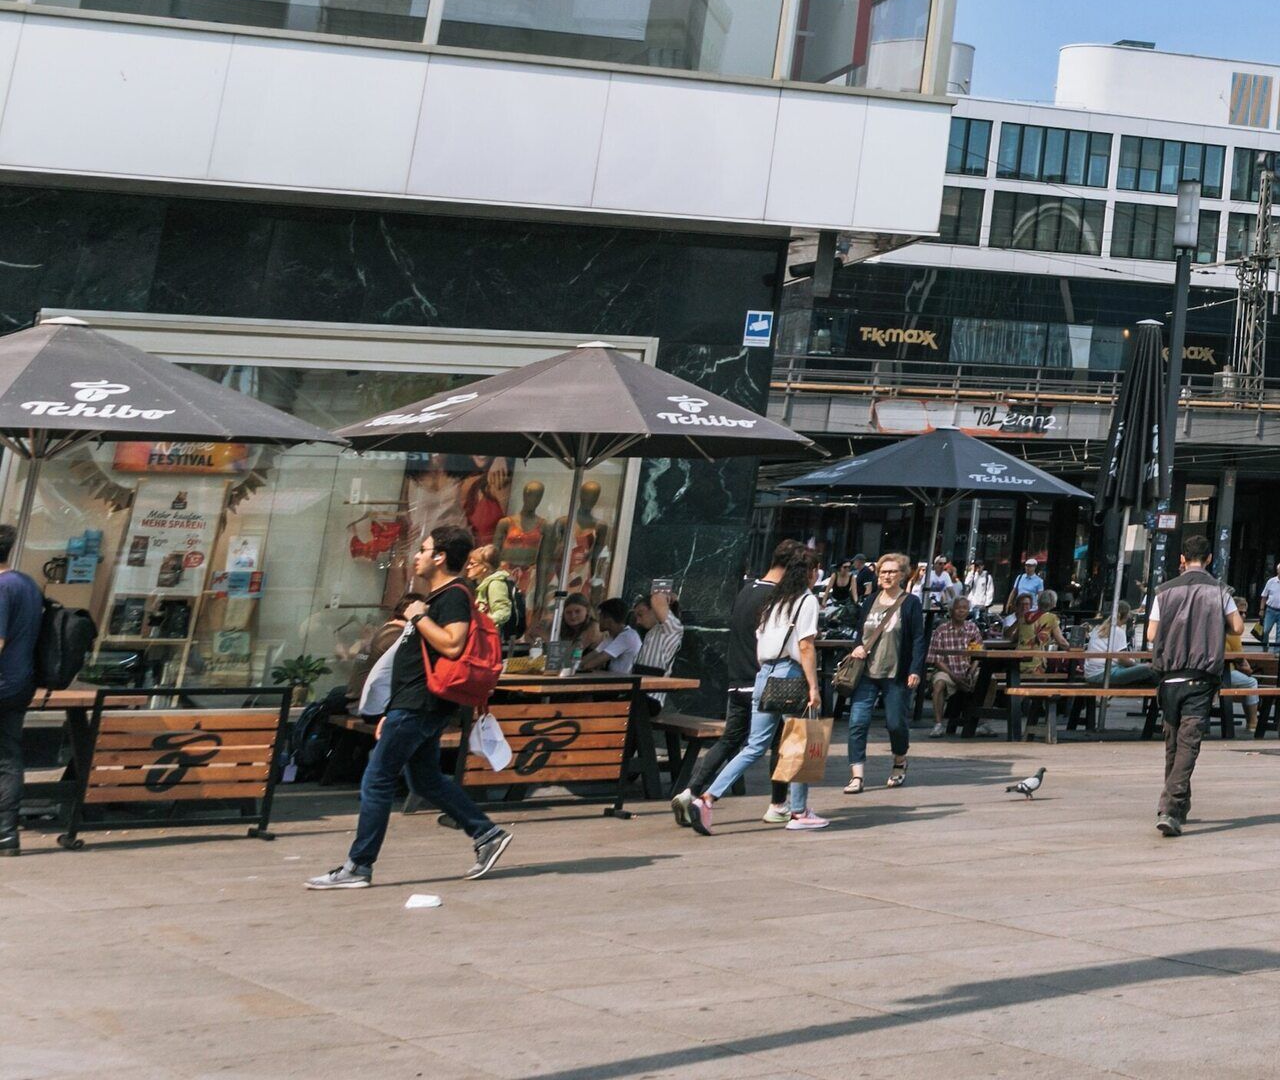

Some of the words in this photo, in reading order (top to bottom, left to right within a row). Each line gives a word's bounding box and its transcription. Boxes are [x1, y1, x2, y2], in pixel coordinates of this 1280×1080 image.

[20, 400, 176, 420] Tchibo
[657, 412, 757, 429] Tchibo
[148, 453, 215, 467] FESTIVAL
[969, 473, 1036, 485] Tchibo
[141, 520, 166, 528] MEHR
